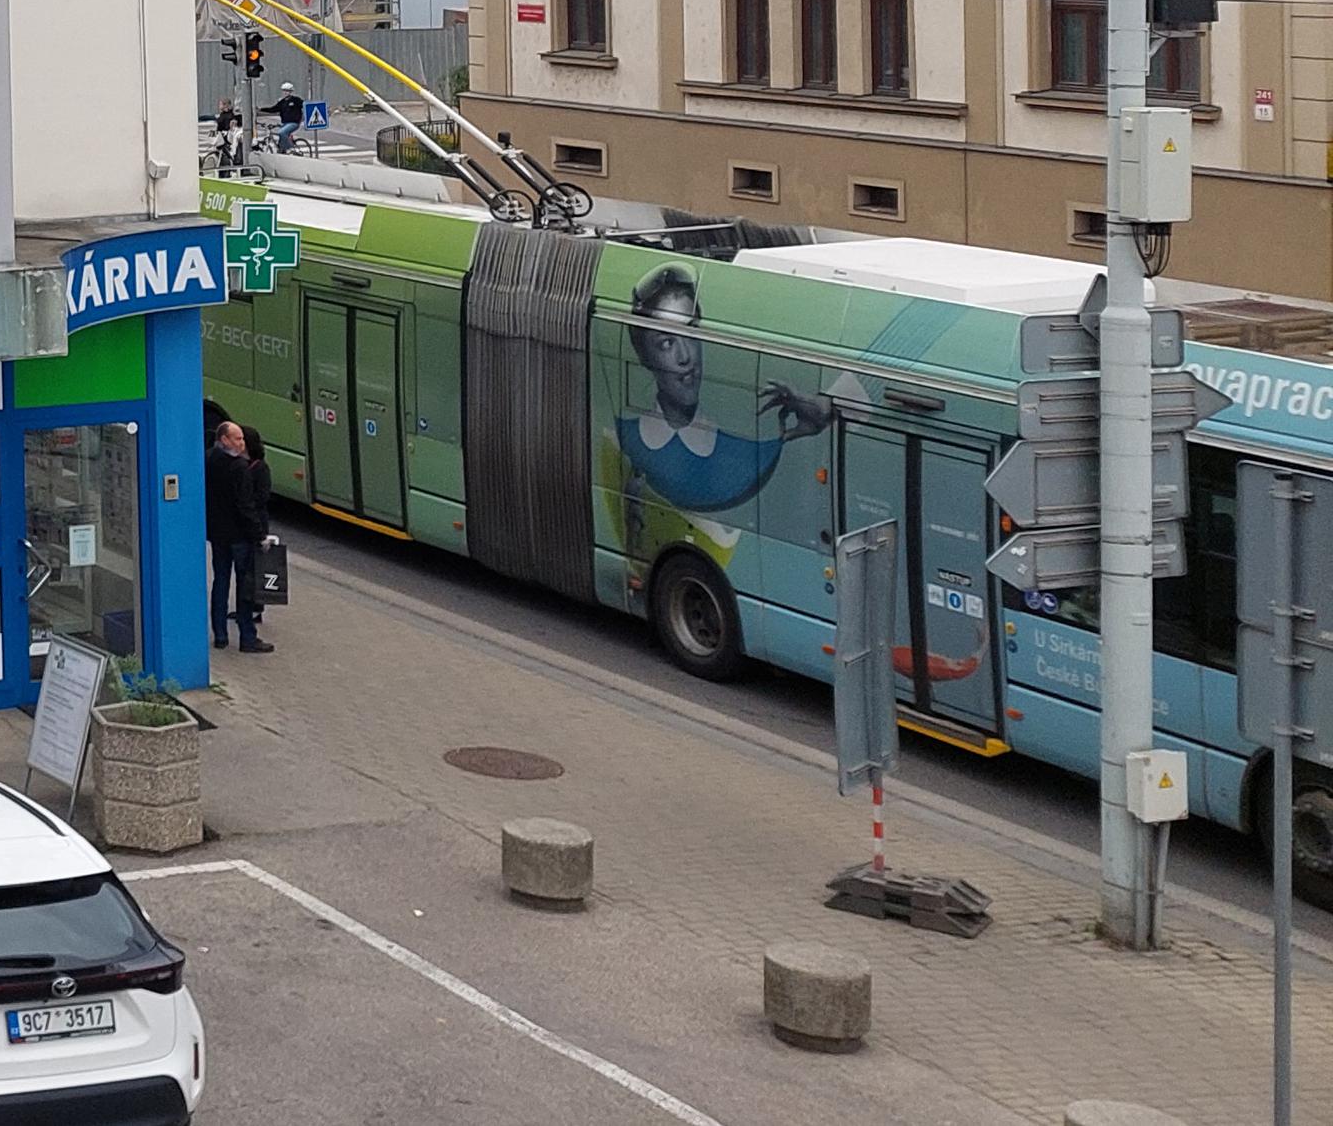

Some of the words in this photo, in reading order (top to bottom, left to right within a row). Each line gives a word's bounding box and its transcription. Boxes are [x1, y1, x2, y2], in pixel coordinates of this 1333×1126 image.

[1255, 90, 1272, 99] 241
[205, 192, 227, 211] 500
[1035, 630, 1046, 647] U
[1036, 655, 1080, 687] České
[22, 1012, 52, 1033] 9C7
[65, 1005, 105, 1028] 3517
